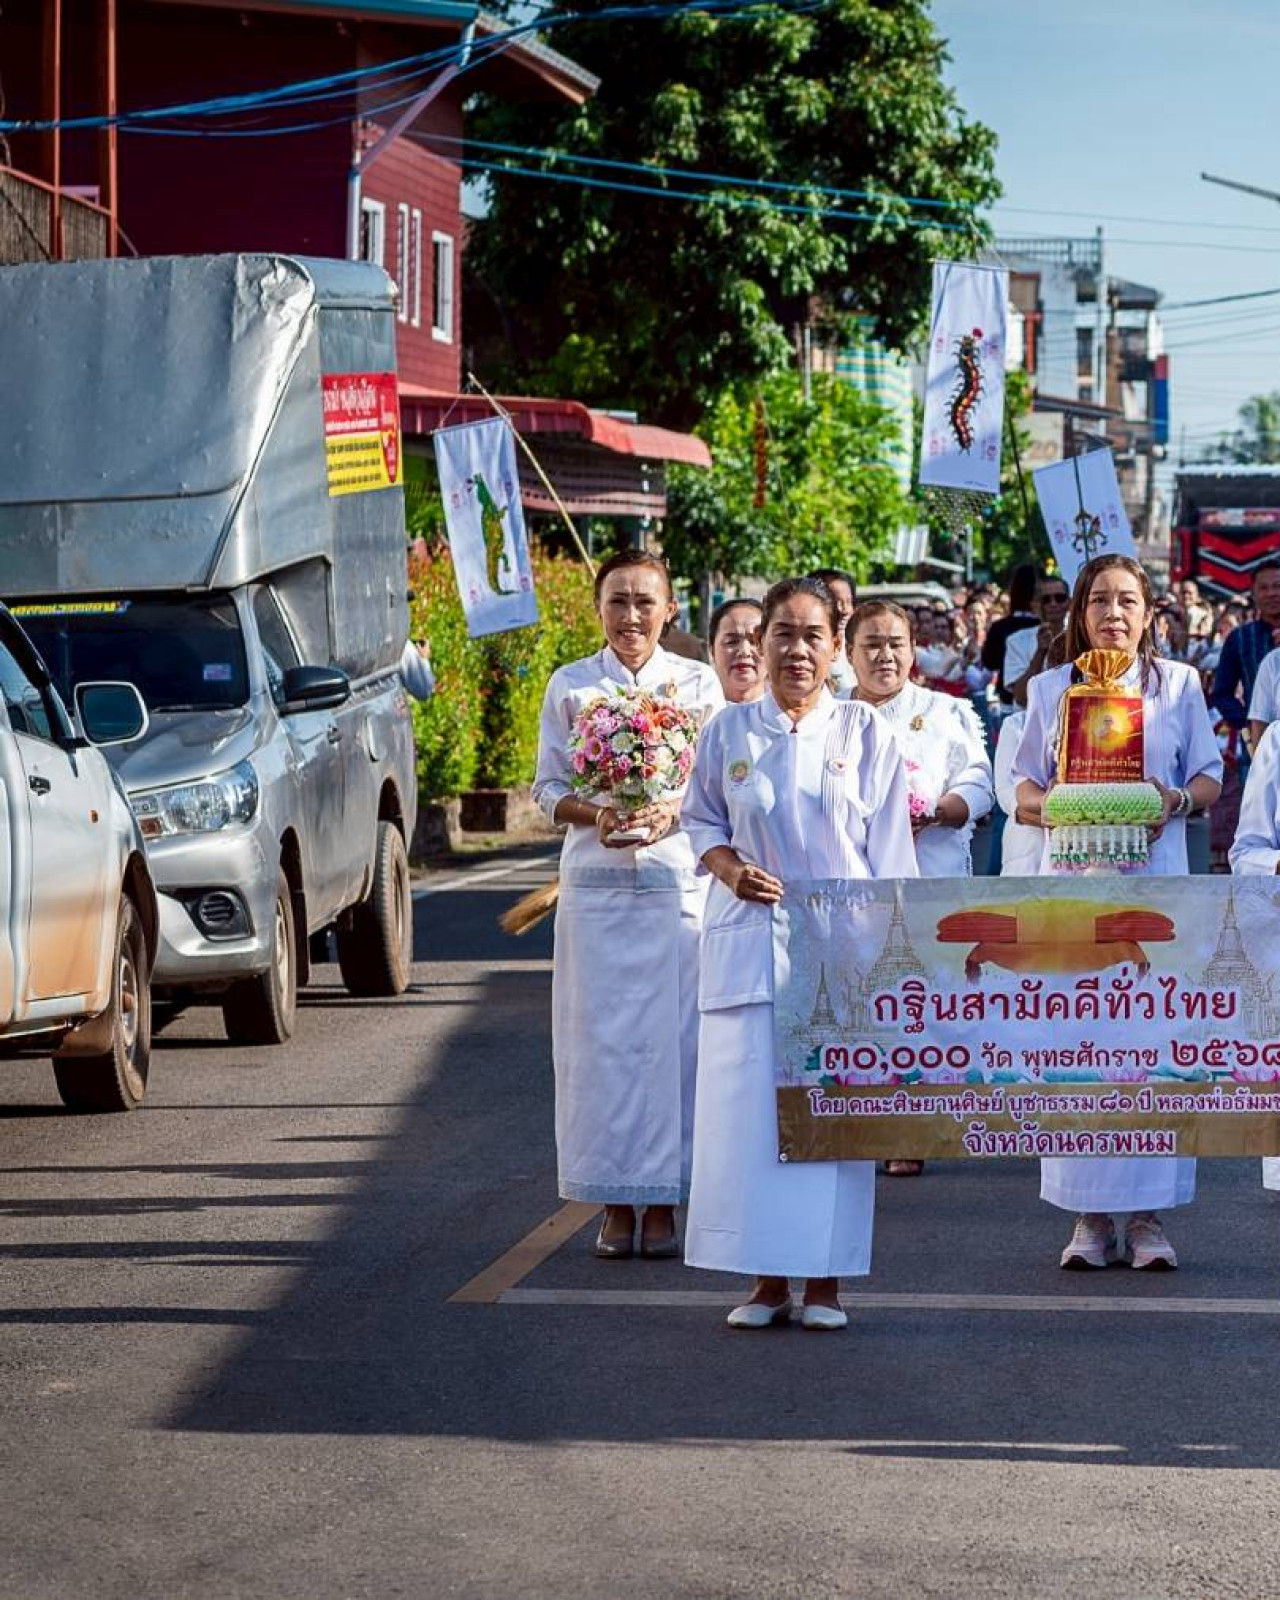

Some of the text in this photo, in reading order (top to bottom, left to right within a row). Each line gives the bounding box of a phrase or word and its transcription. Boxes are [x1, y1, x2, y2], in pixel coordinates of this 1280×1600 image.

[874, 967, 1237, 1034] กฐินสามัคคีทั่วไทย
[824, 1045, 971, 1074] ๓๐,๐๐๐
[981, 1042, 1013, 1068] วัด
[1021, 1041, 1158, 1077] พุทธศักราช
[810, 1090, 844, 1114] โดย
[850, 1088, 1002, 1120] คณะศิษยานุศิษย์
[1010, 1095, 1093, 1119] บูชาธรรม
[1138, 1090, 1151, 1110] ปี
[964, 1122, 1175, 1153] จังหวัดนครพนม
